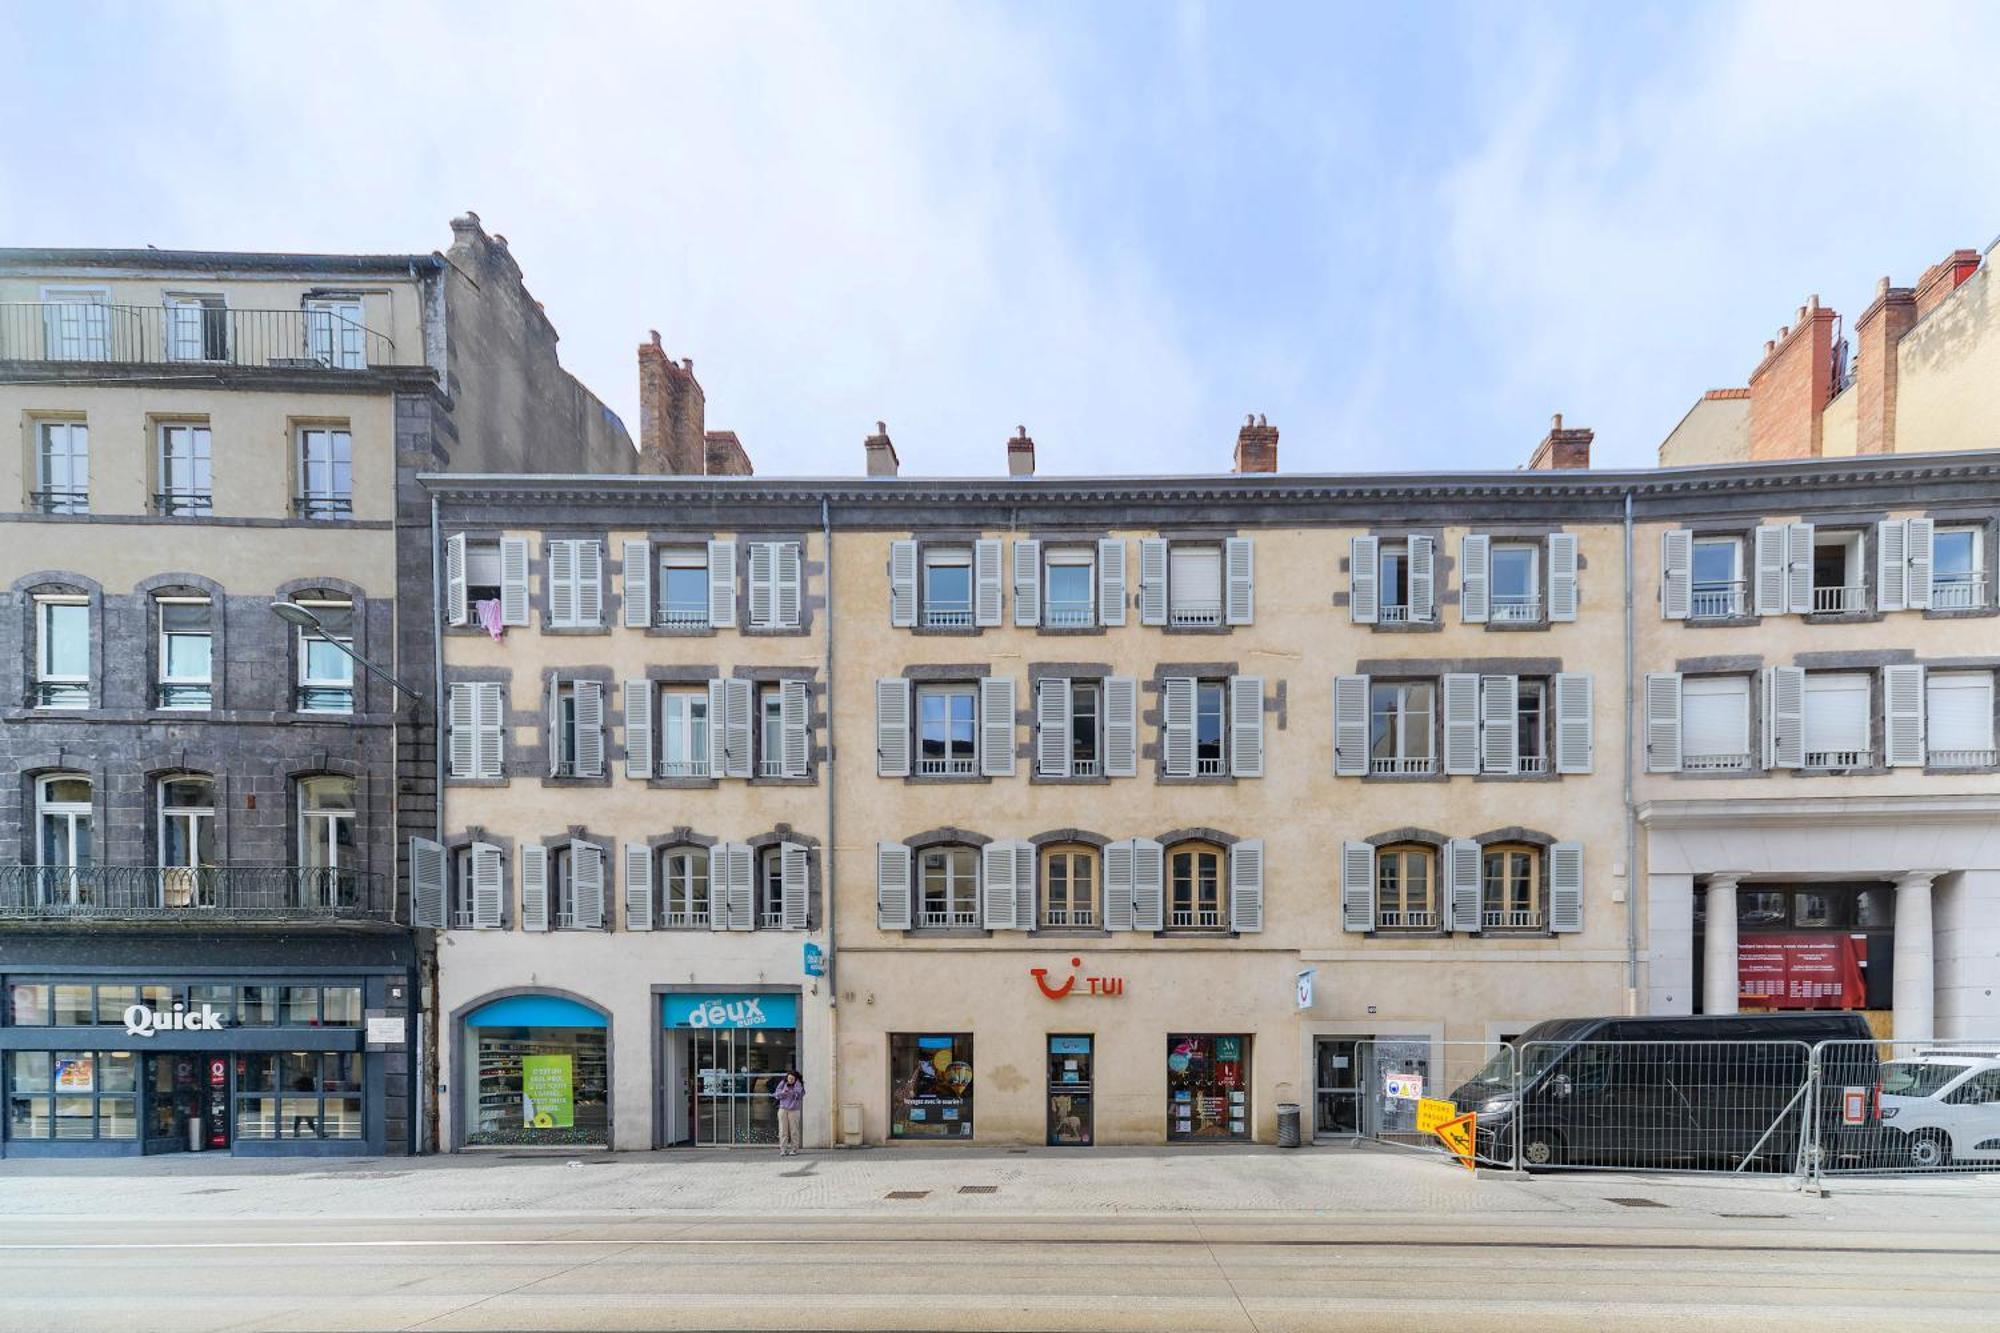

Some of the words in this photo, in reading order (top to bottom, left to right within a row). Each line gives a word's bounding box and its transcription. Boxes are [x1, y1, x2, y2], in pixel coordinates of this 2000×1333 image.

[1086, 977, 1123, 995] TUI
[123, 1003, 224, 1037] Quick
[689, 998, 764, 1028] deux
